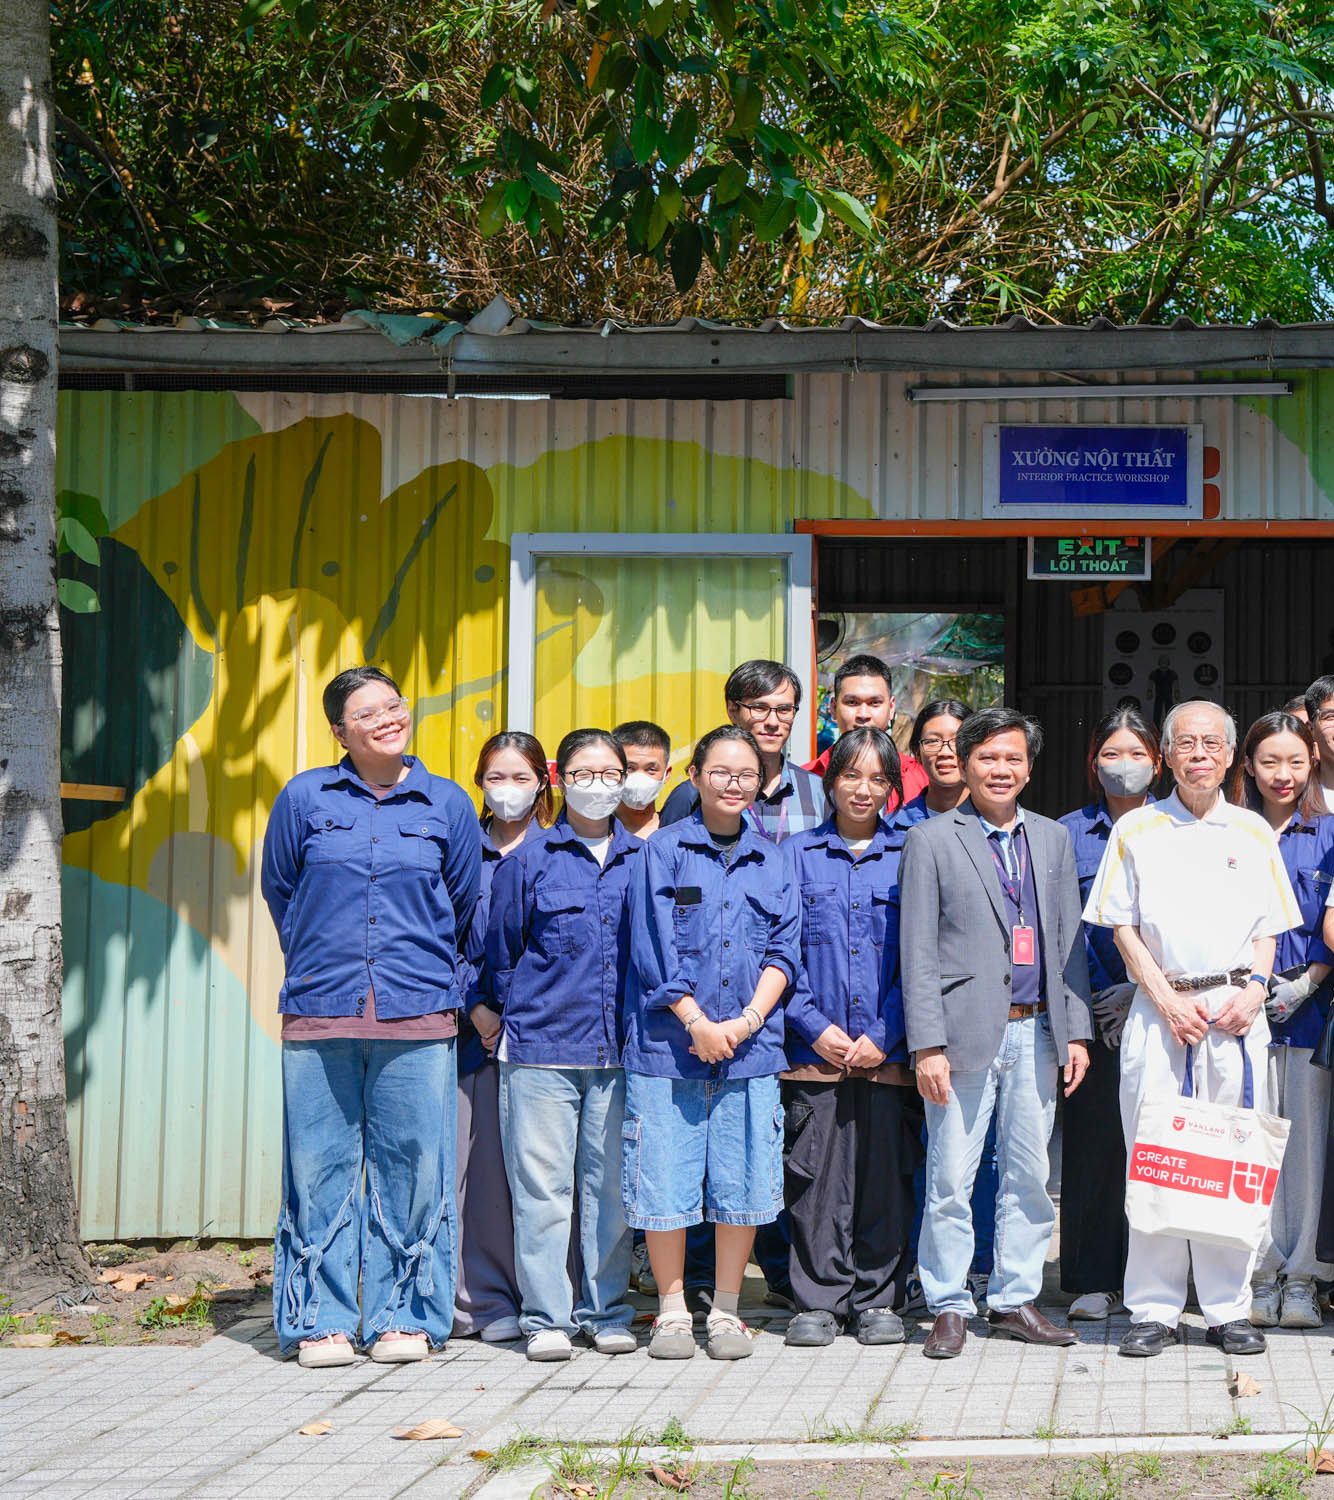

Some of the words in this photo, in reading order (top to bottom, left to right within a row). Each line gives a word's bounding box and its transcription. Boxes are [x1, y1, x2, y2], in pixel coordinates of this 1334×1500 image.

[1011, 447, 1080, 467] XƯỞNG
[1084, 448, 1119, 470] NỘI
[1123, 448, 1176, 467] THẤT
[1017, 472, 1064, 482] INTERIOR
[1066, 473, 1113, 482] PRACTICE
[1115, 473, 1170, 483] WORKSHOP
[1058, 539, 1121, 555] EXIT
[1050, 555, 1076, 571] LỐI
[1079, 557, 1129, 572] THOÁT
[1136, 1150, 1188, 1169] CREATE
[1135, 1165, 1170, 1181] YOUR
[1171, 1172, 1225, 1193] FUTURE
